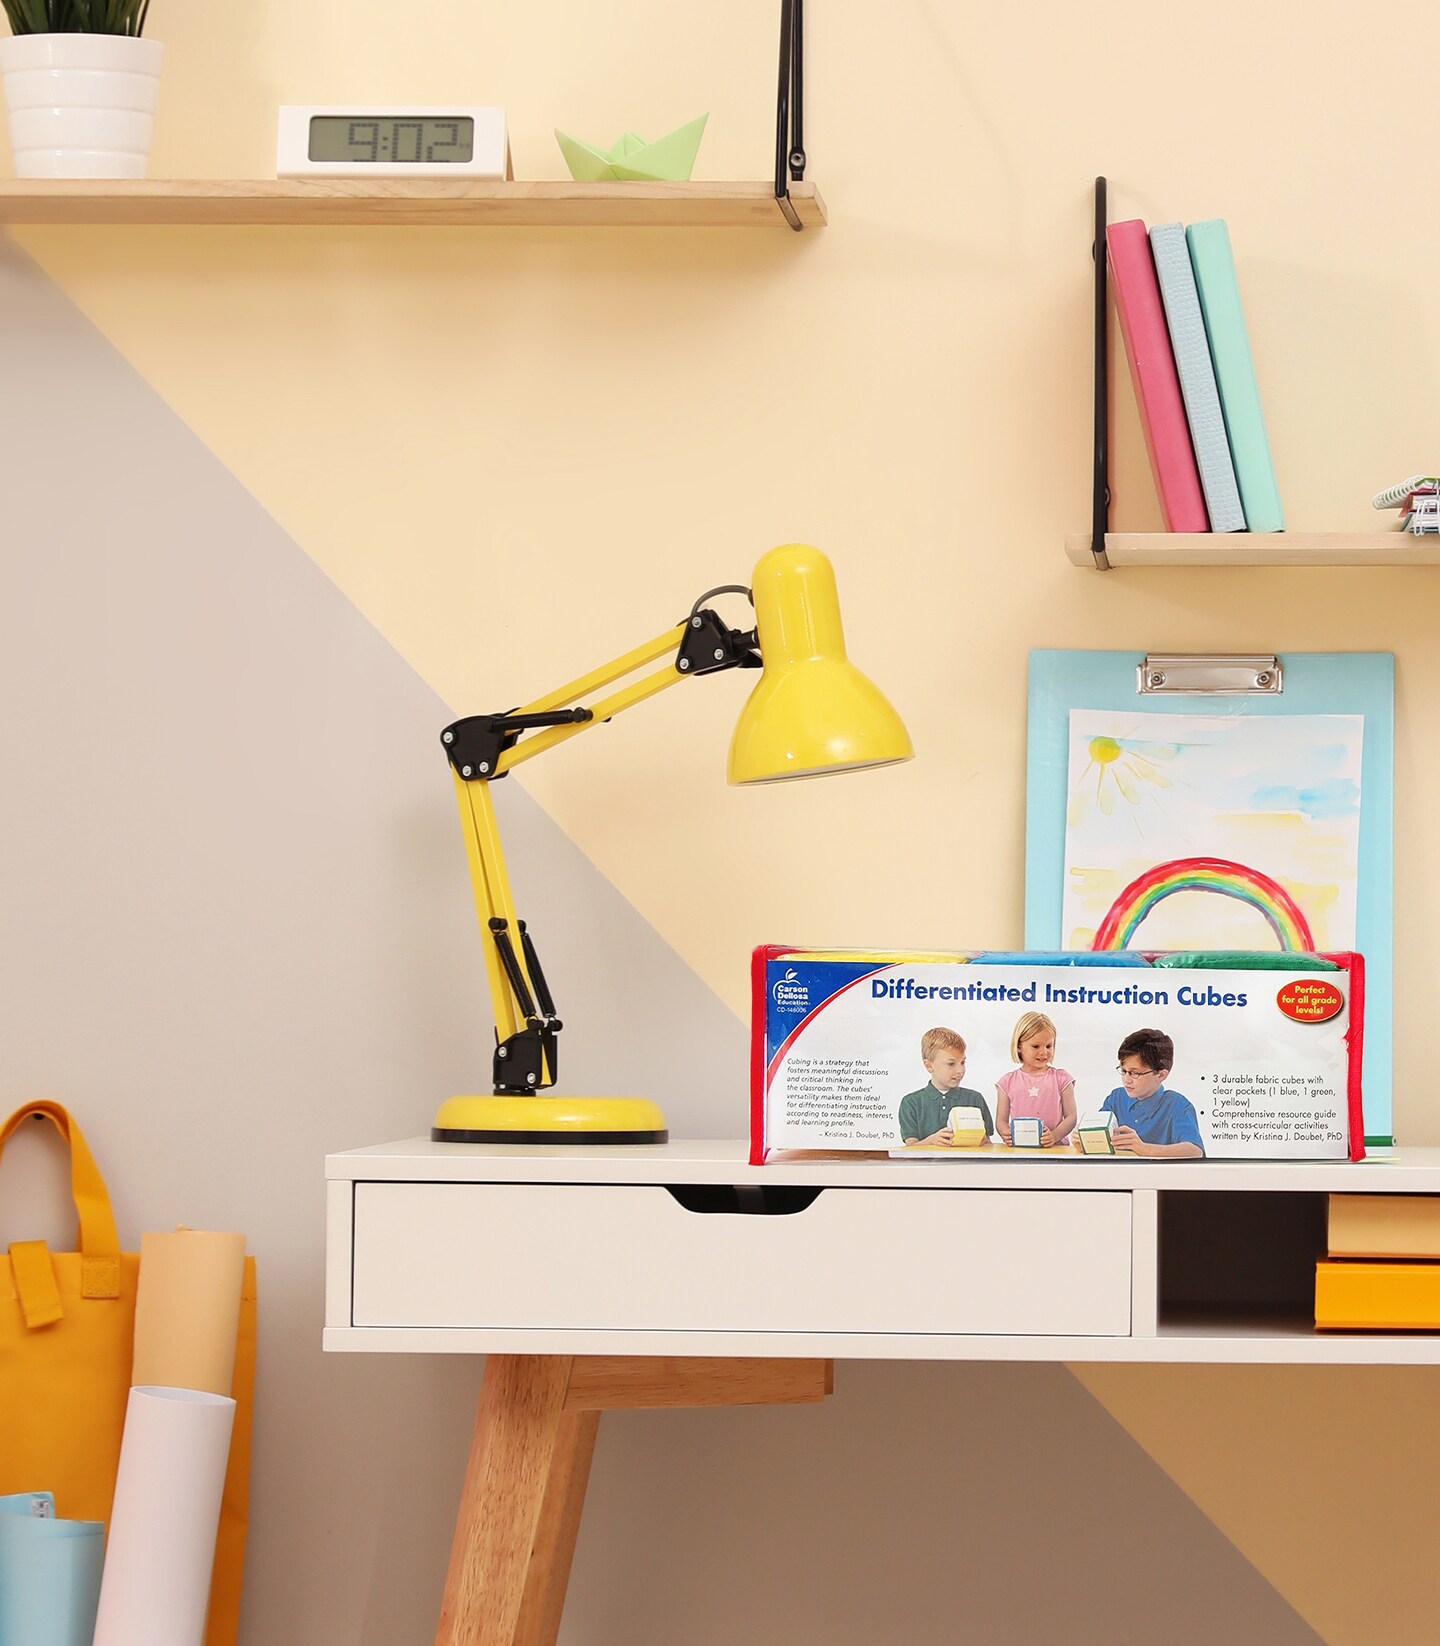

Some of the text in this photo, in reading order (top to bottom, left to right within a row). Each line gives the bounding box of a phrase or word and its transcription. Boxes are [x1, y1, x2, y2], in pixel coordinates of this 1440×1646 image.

[348, 122, 459, 162] 9:02
[777, 984, 808, 992] Carson
[871, 978, 1248, 1007] Differentiated Instruction Cubes
[1294, 985, 1326, 994] Perfect
[777, 992, 808, 1000] Dellosa
[1281, 994, 1337, 1006] for all grade
[1295, 1005, 1324, 1014] levels!
[786, 1057, 811, 1066] Cubing
[825, 1059, 854, 1067] strategy
[855, 1059, 870, 1067] that
[786, 1066, 810, 1074] fosters
[811, 1067, 851, 1076] meaningful
[825, 1076, 854, 1084] thinking
[1212, 1074, 1324, 1084] 3 durable fabric cubes with
[799, 1084, 835, 1092] classroom.
[1212, 1085, 1233, 1095] clear
[1235, 1086, 1267, 1096] pockets
[1268, 1086, 1276, 1097] (1
[1279, 1086, 1300, 1097] blue,
[1310, 1088, 1336, 1097] green,
[786, 1093, 820, 1101] versatility
[798, 1102, 848, 1110] differentiating
[1220, 1097, 1251, 1108] yellow)
[786, 1110, 820, 1118] according
[830, 1111, 864, 1119] readiness,
[865, 1112, 894, 1120] interest,
[1211, 1109, 1337, 1120] Comprehensive resource guide
[801, 1119, 830, 1127] learning
[830, 1119, 856, 1127] profile.
[1211, 1119, 1329, 1130] with cross-curricular activities
[824, 1130, 848, 1138] Kristina
[855, 1131, 881, 1139] Doubet,
[882, 1131, 895, 1139] PhD
[1211, 1131, 1343, 1142] written by Kristina J. Doubet, PhD
